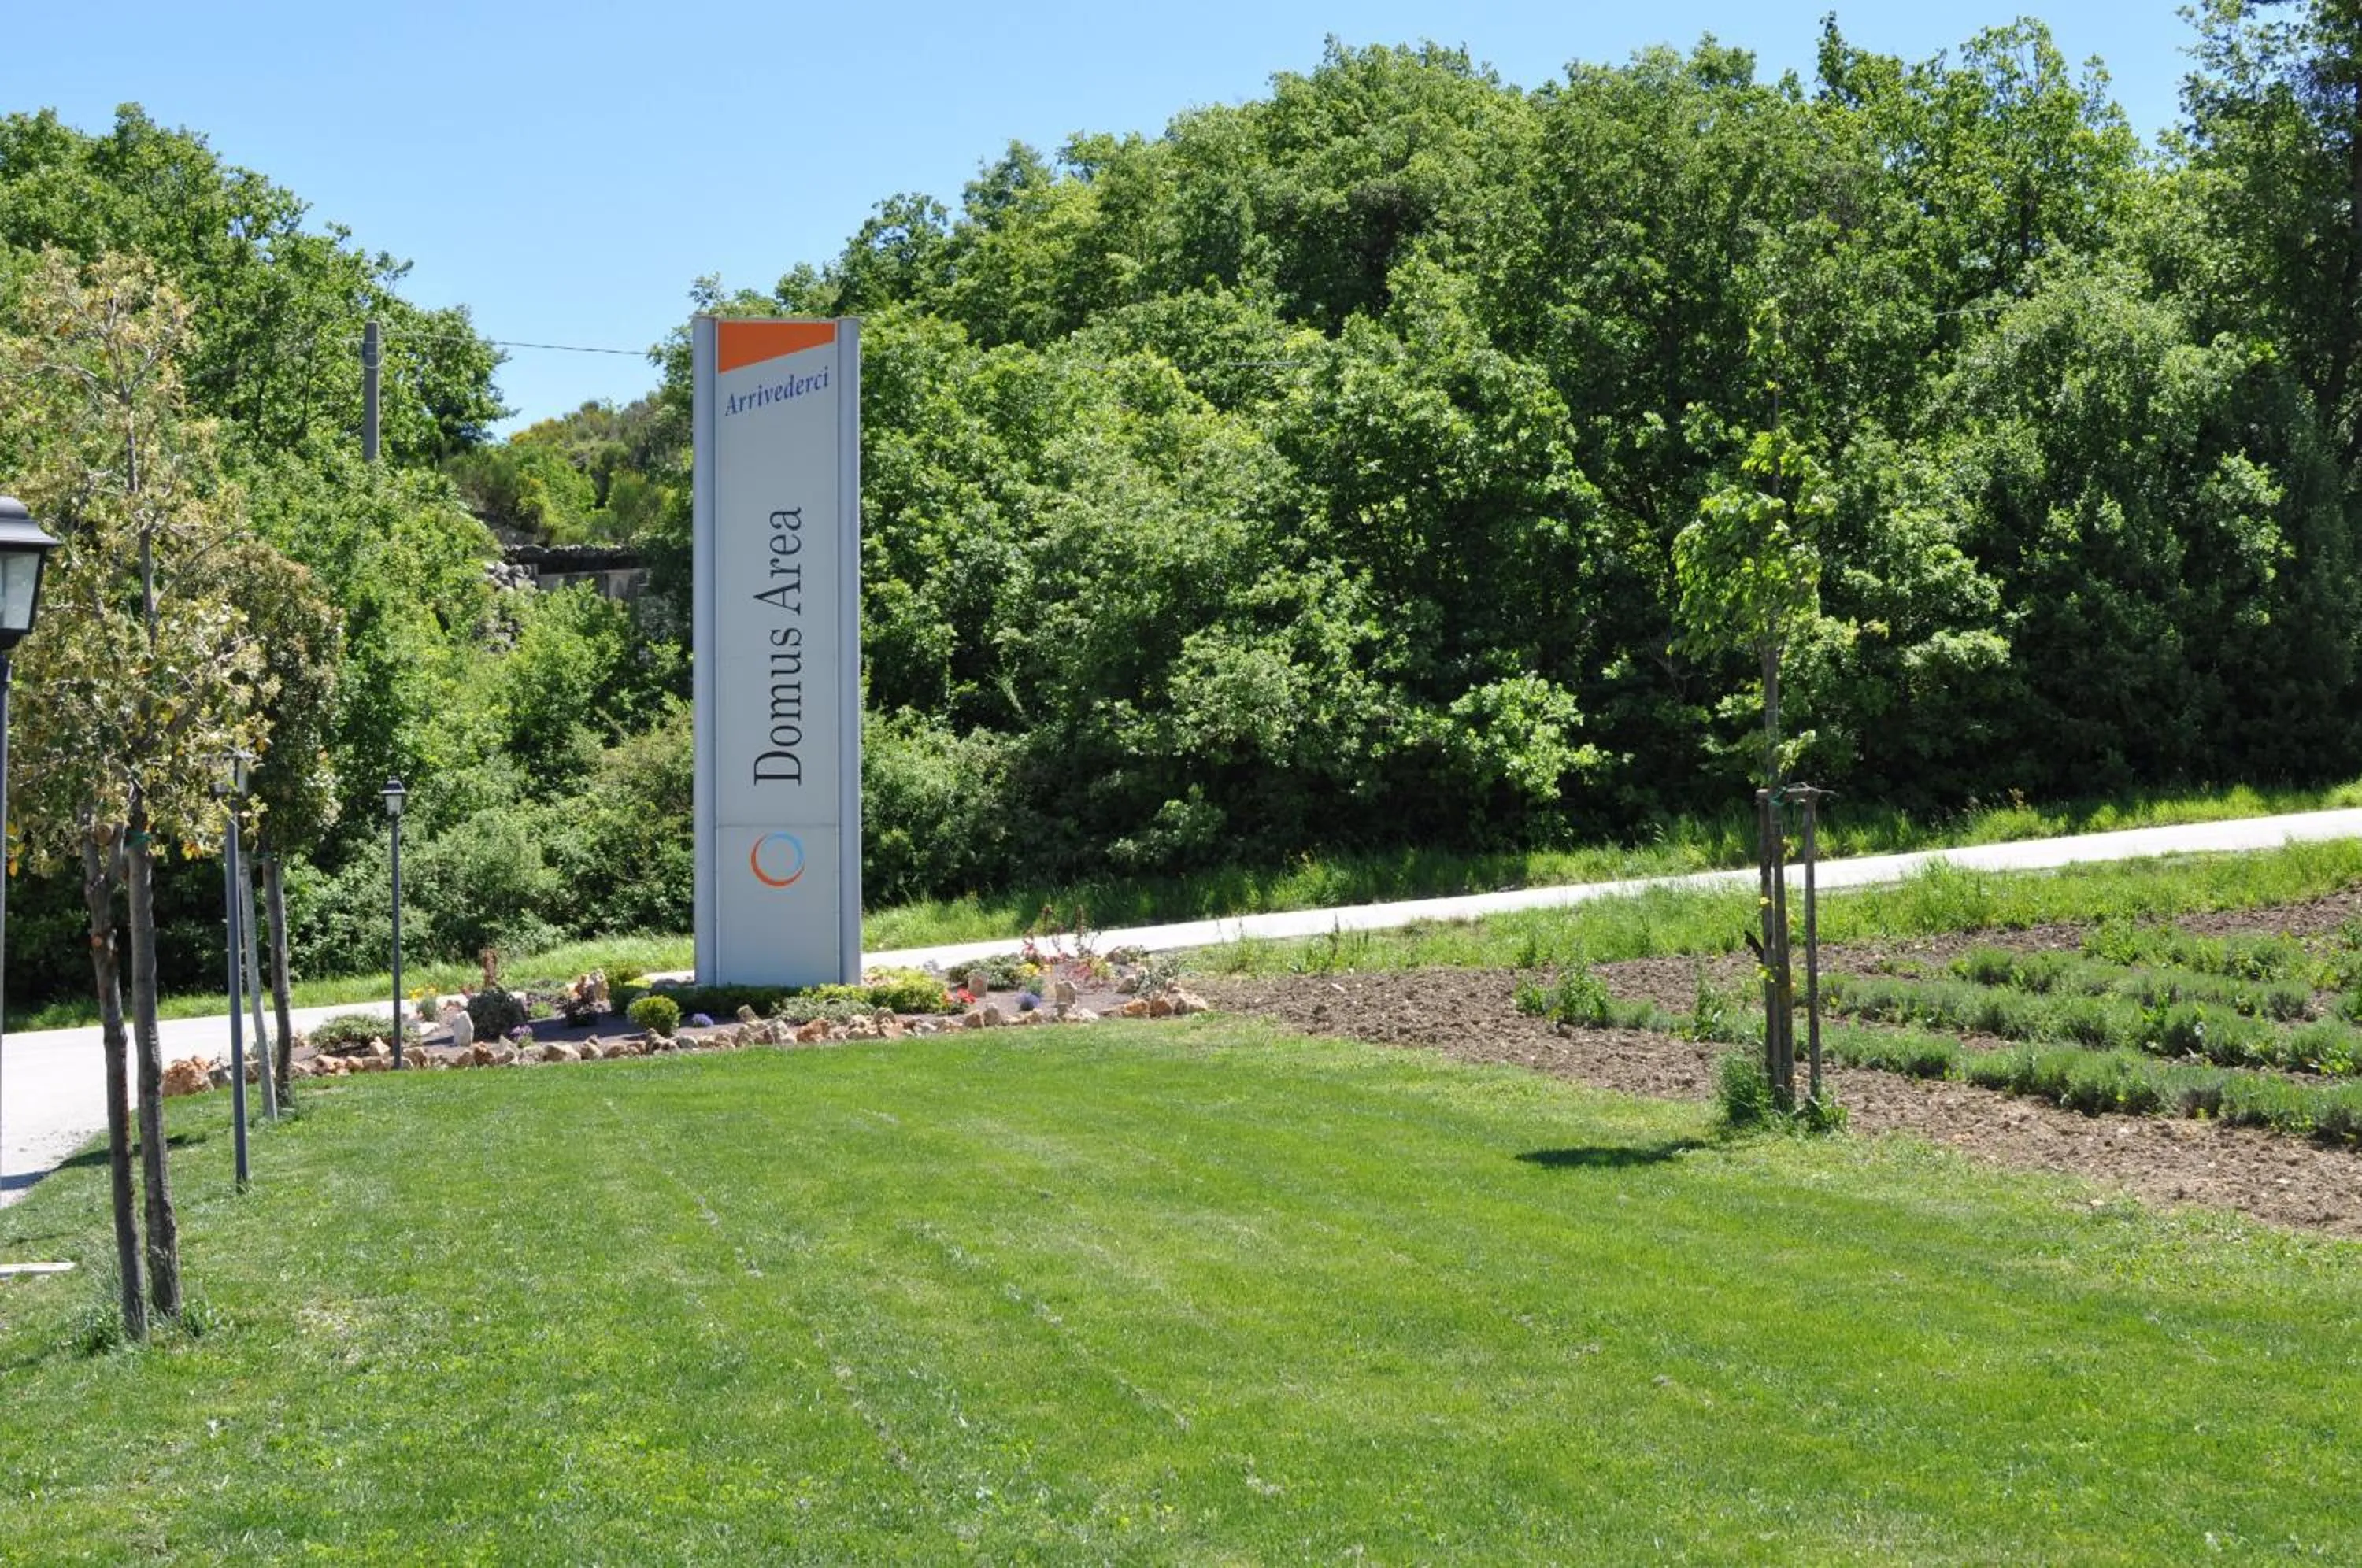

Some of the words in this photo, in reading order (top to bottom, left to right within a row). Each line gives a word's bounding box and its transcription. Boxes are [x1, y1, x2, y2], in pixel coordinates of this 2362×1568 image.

[725, 365, 829, 416] Arrivederci
[753, 506, 802, 615] Area
[753, 627, 802, 786] Domus
